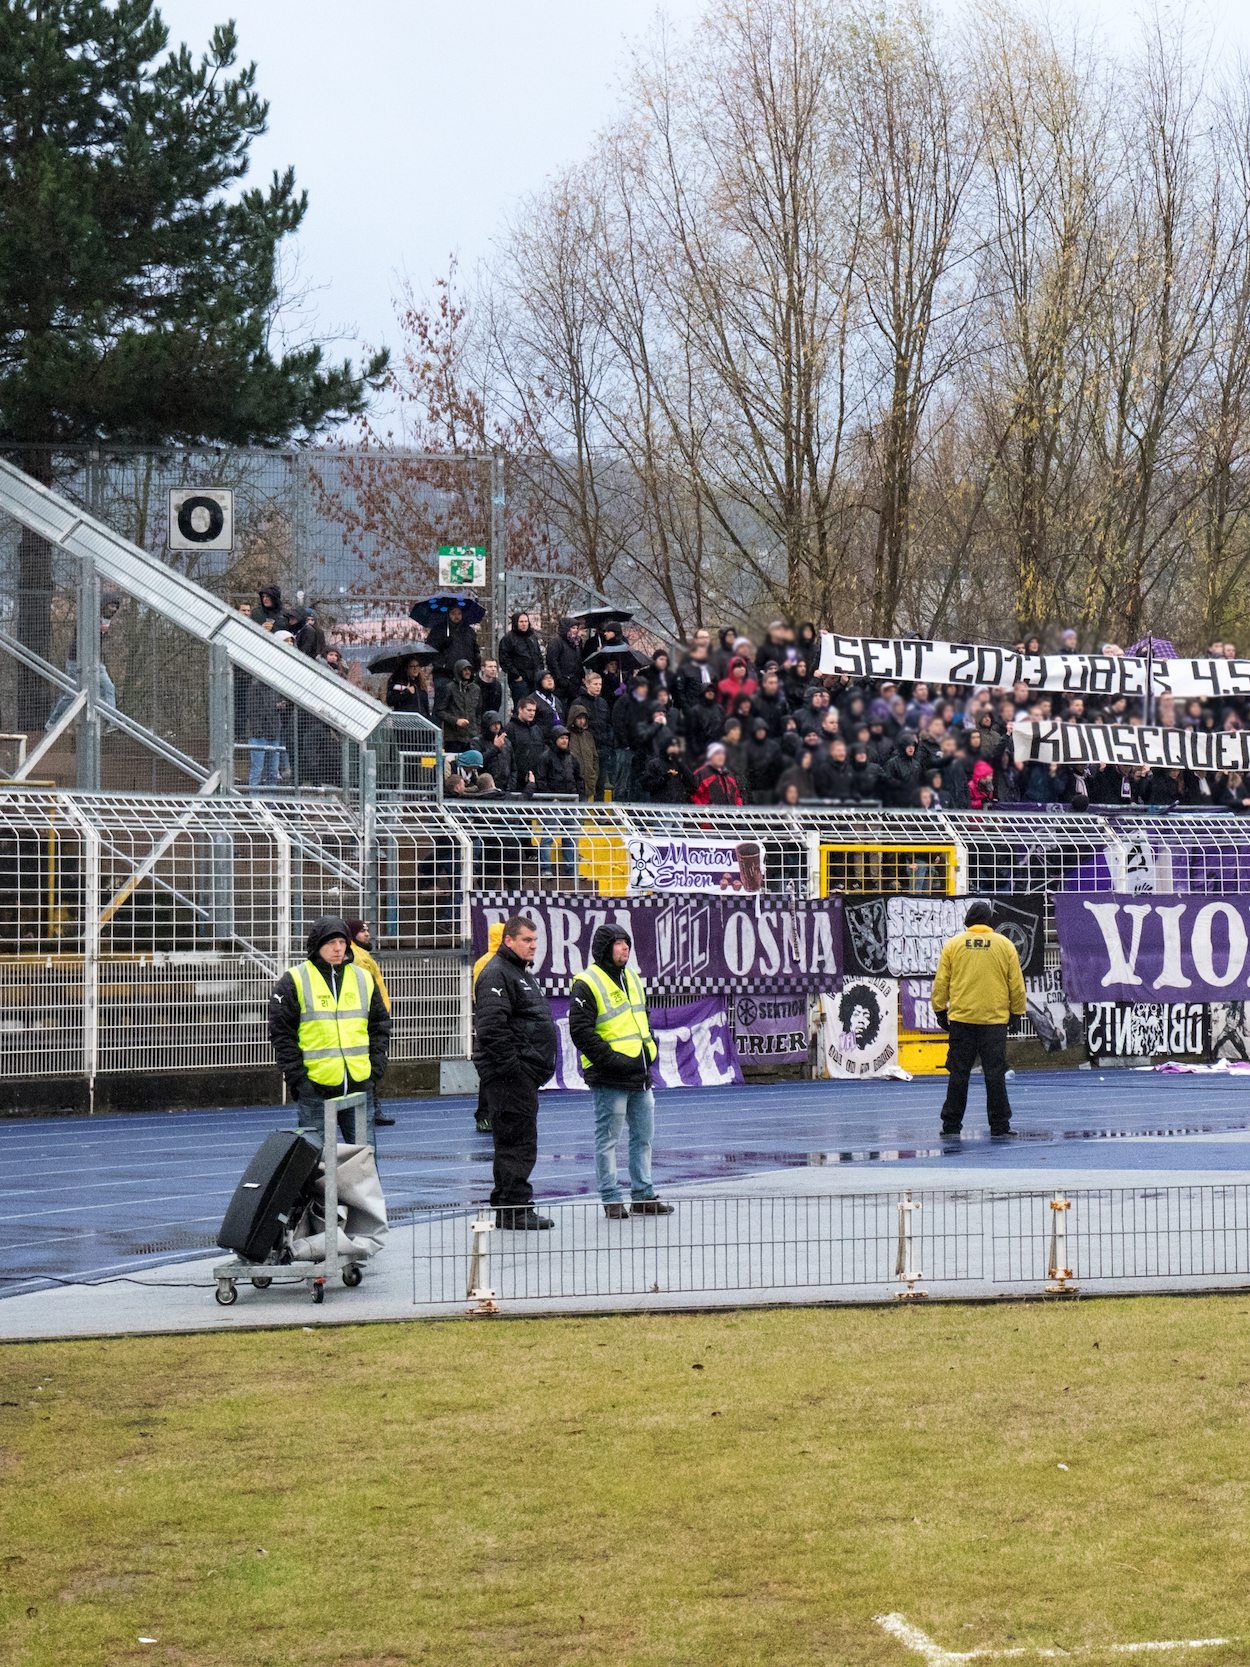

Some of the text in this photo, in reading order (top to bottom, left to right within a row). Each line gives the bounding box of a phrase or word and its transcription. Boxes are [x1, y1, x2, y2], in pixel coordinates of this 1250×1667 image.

[834, 635, 933, 678] SEIT
[1064, 655, 1171, 696] ÜBER
[652, 842, 733, 866] Marias
[654, 865, 713, 888] Erben
[723, 911, 837, 976] OSNA
[757, 1000, 806, 1020] SEKTION
[736, 1031, 808, 1056] TRIER
